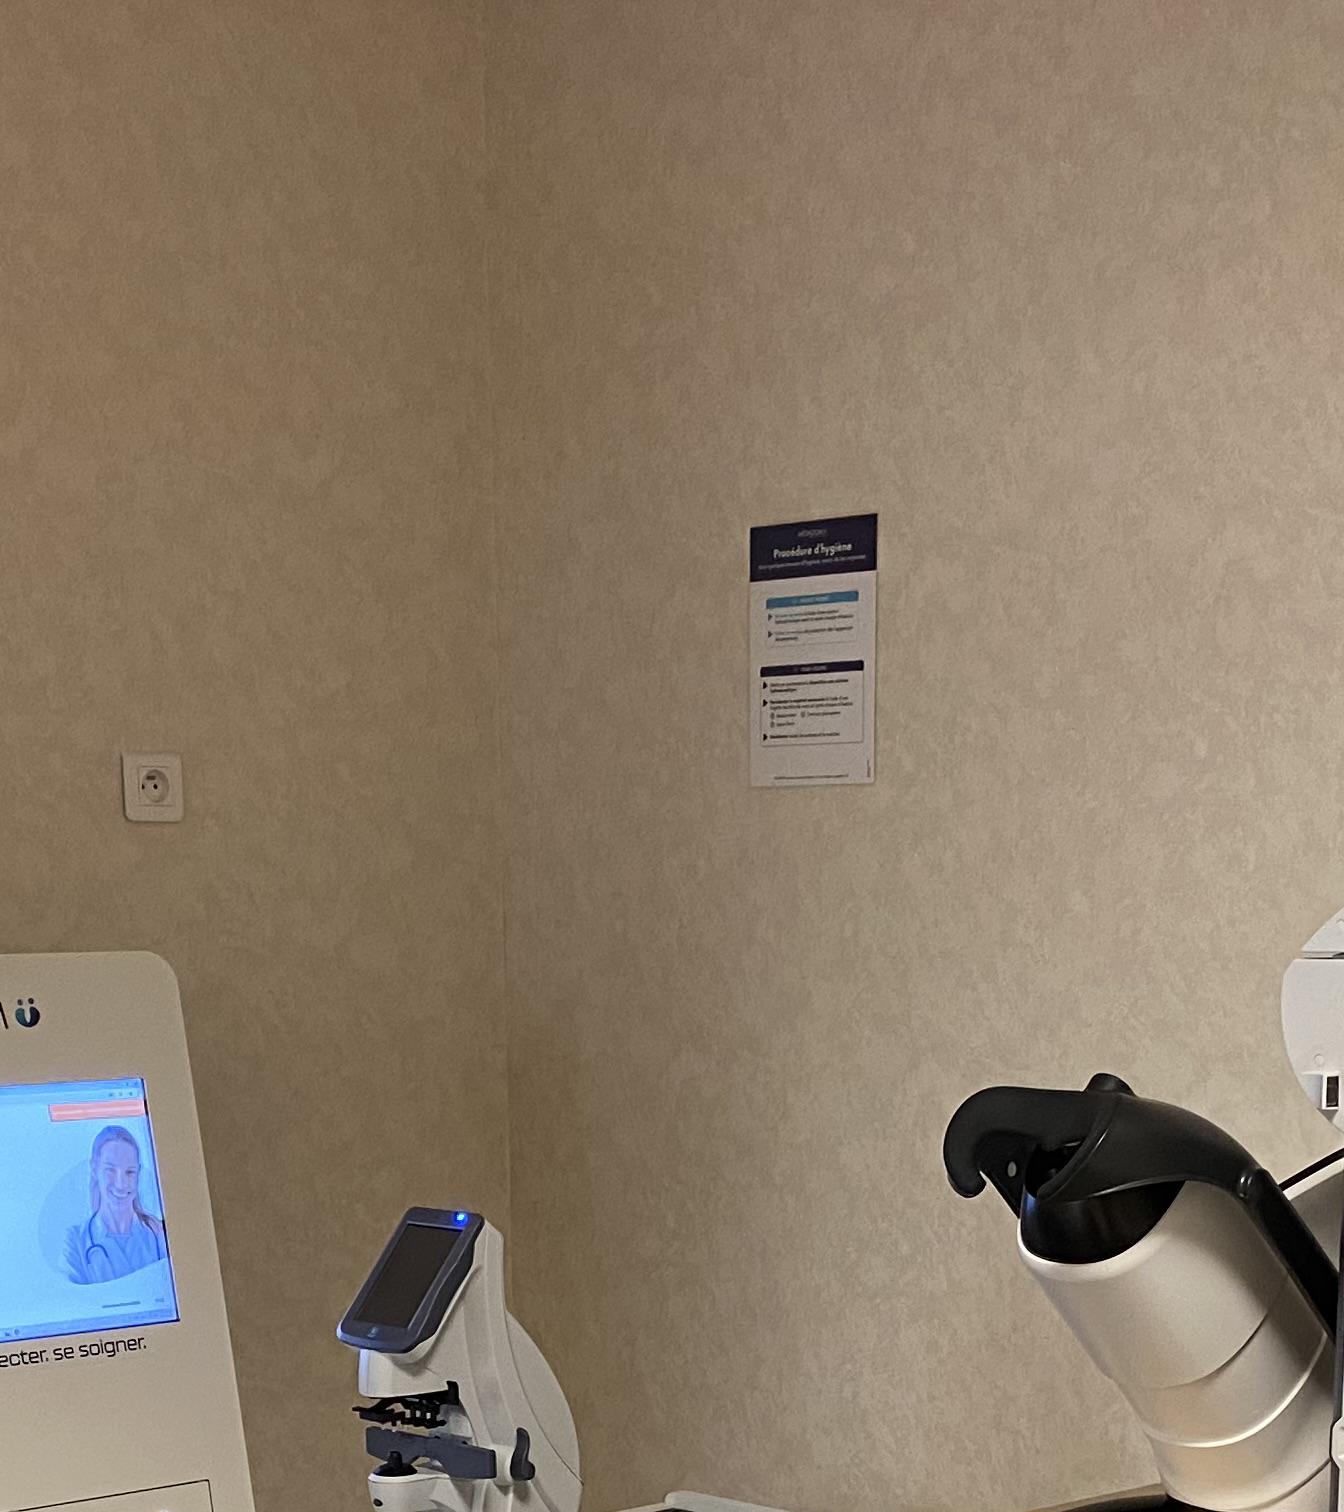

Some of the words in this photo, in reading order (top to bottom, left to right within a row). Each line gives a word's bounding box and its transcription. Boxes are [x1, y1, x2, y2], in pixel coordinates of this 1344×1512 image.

[773, 546, 812, 559] Procédure
[814, 543, 852, 556] d'hygiène
[53, 1346, 75, 1361] se
[78, 1335, 147, 1358] soigner.
